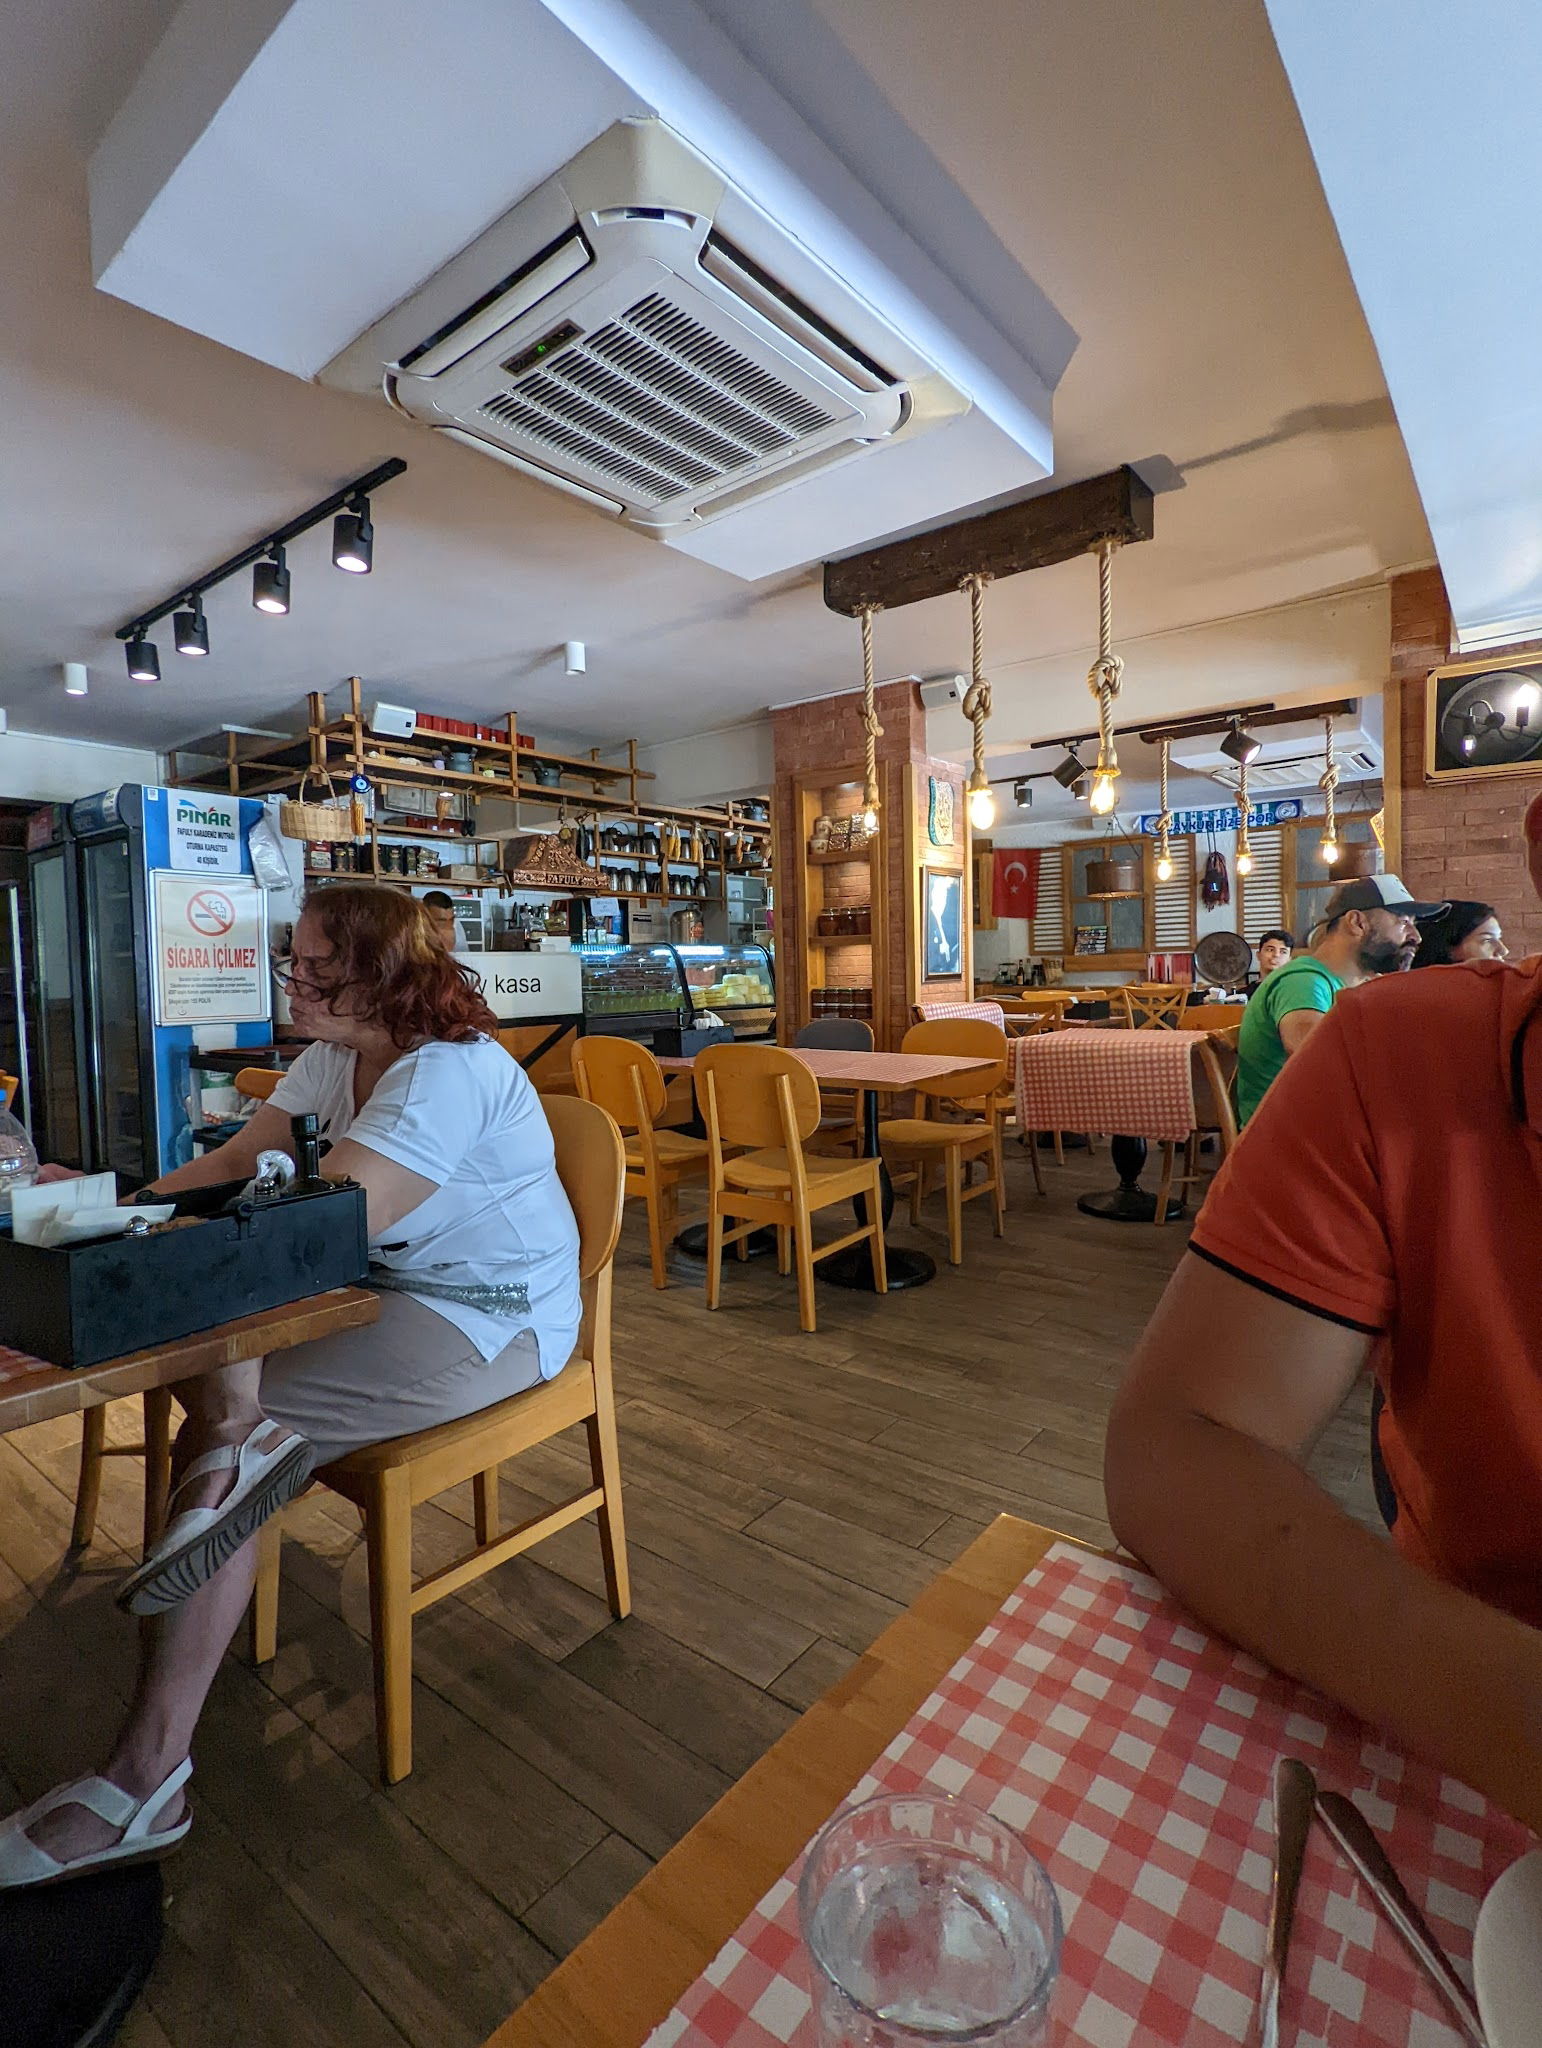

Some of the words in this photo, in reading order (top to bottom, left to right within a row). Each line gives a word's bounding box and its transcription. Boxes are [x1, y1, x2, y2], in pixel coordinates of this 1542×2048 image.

[1216, 813, 1274, 829] RİZEPOR
[547, 874, 581, 884] FAFULY
[167, 943, 210, 968] SİGARA
[213, 943, 256, 973] İÇİLMEZ
[495, 974, 541, 993] kasa
